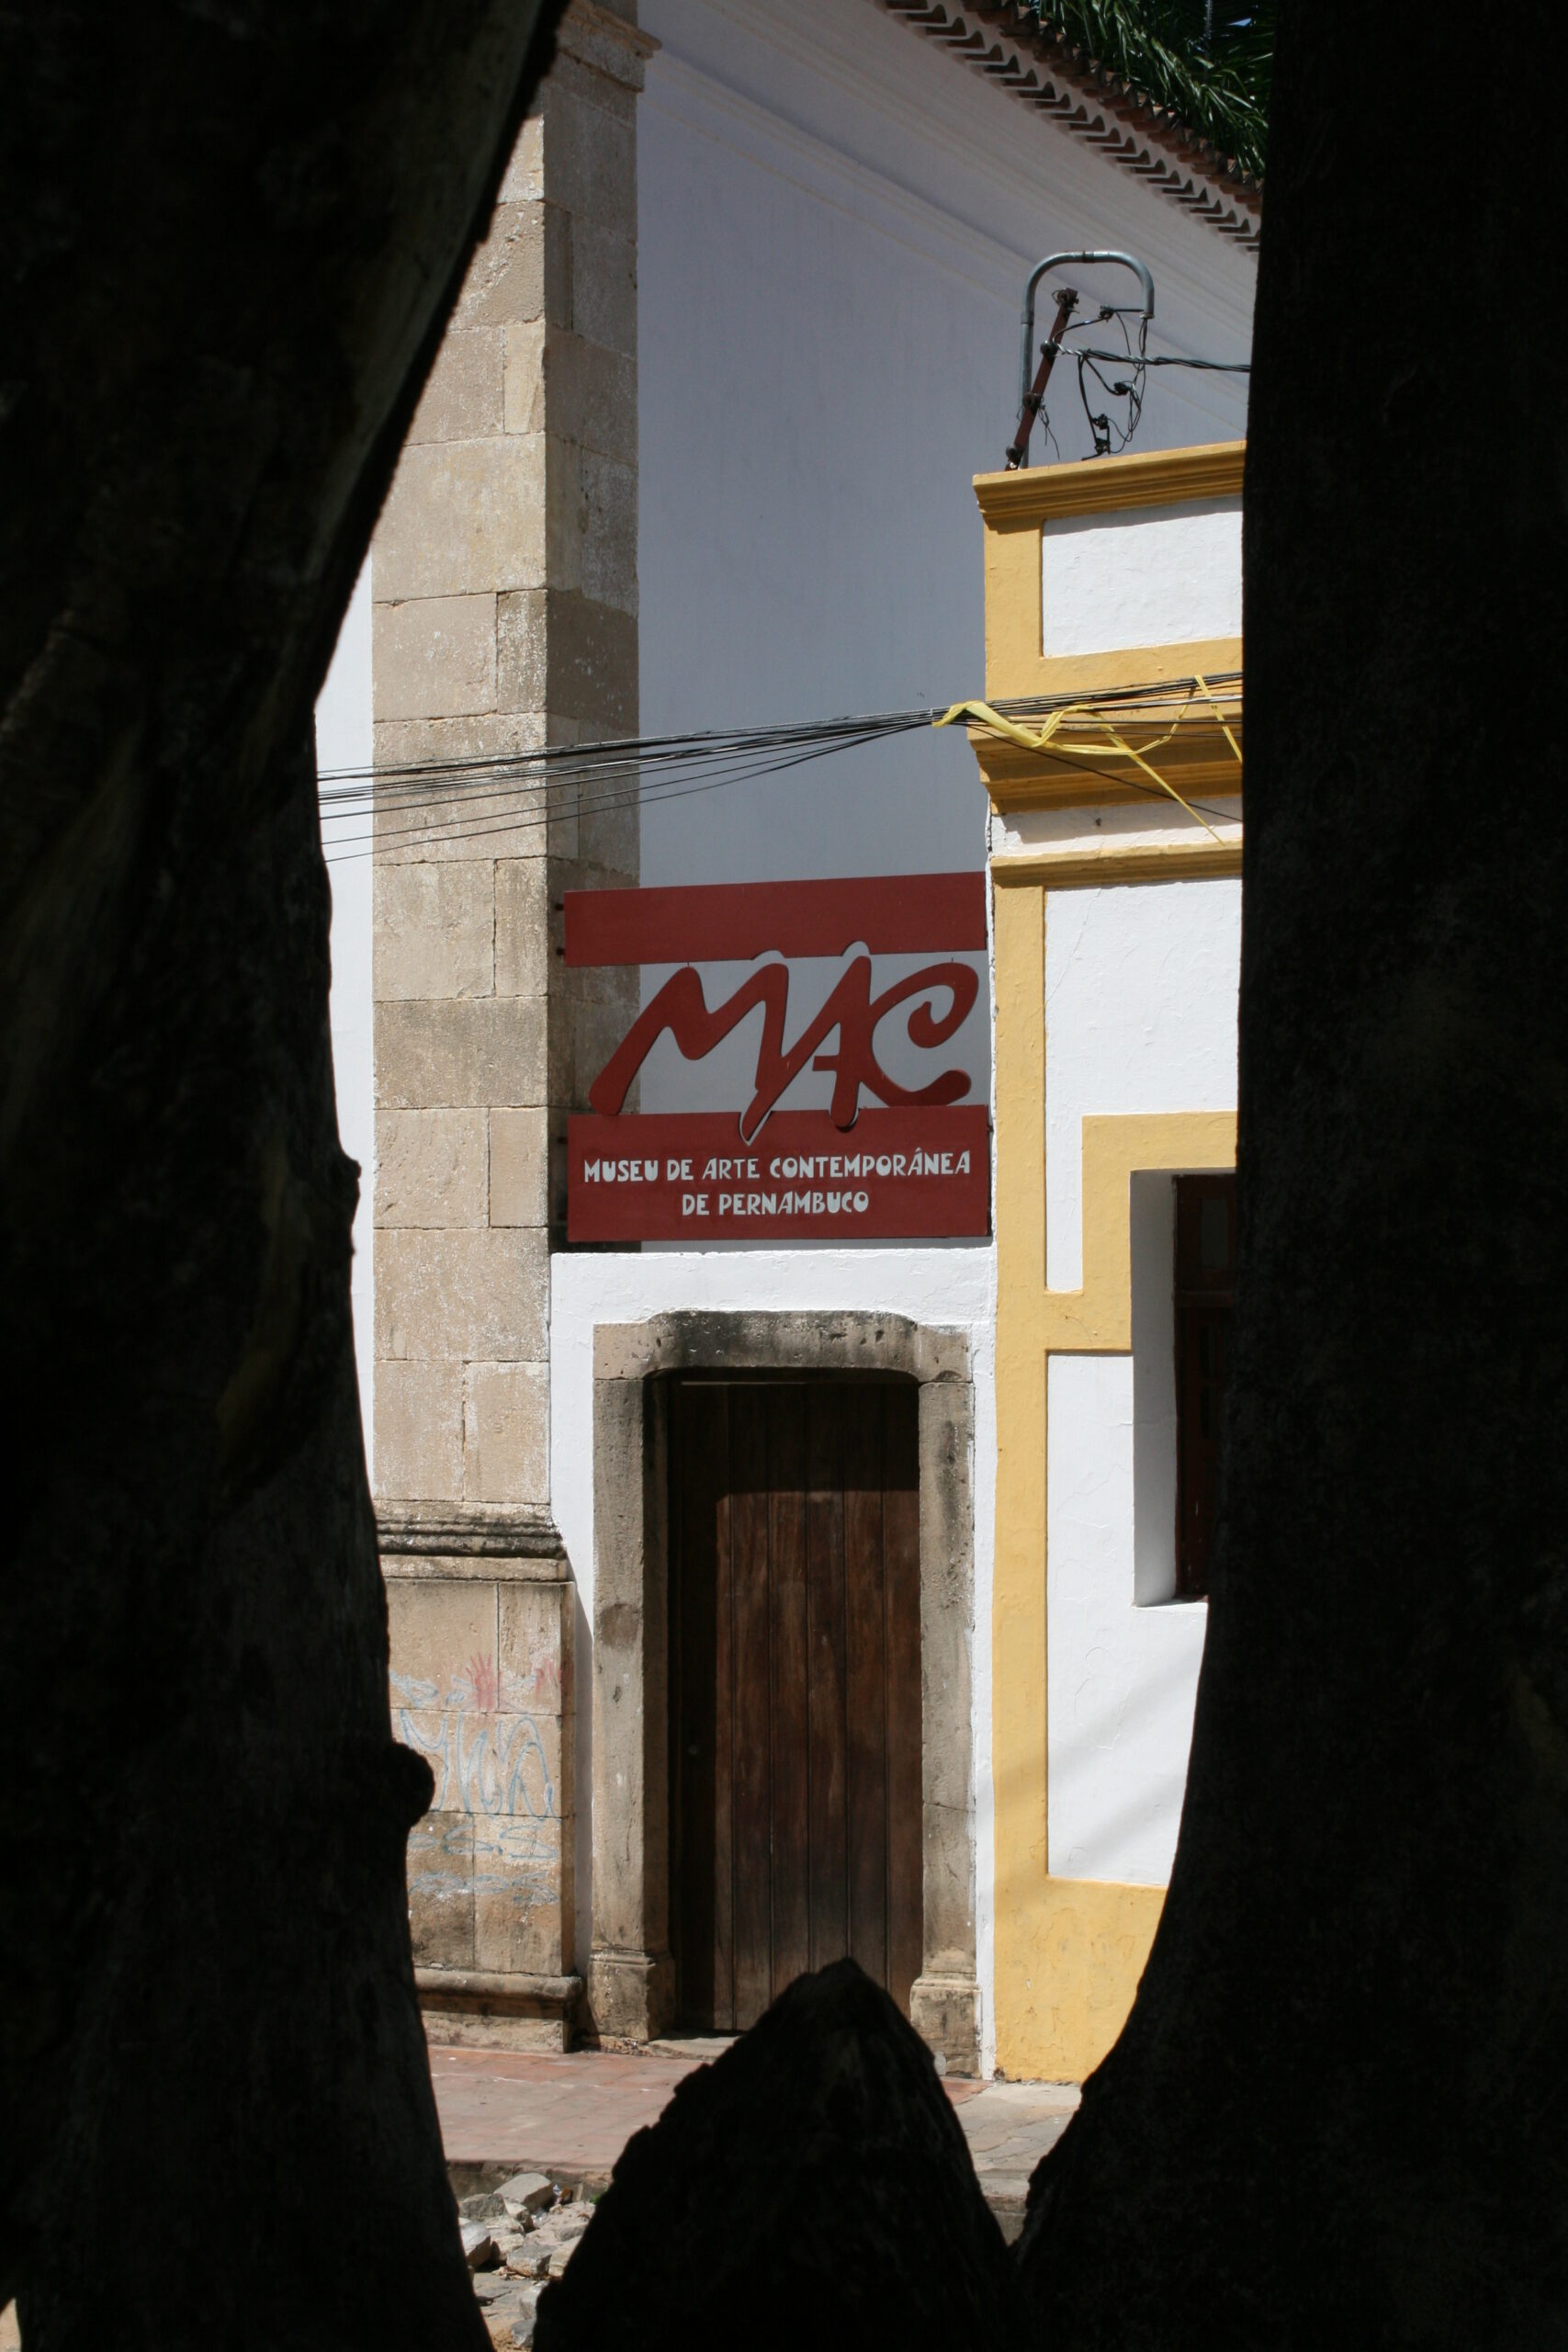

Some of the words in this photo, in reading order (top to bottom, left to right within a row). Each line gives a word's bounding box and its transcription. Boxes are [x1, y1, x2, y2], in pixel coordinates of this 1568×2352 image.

[589, 956, 979, 1140] MAC
[584, 1159, 659, 1182] MUSEU
[667, 1159, 694, 1182] DE
[702, 1158, 761, 1180] ARTE
[682, 1193, 710, 1216] DE
[718, 1190, 869, 1216] PERNAMBUCO
